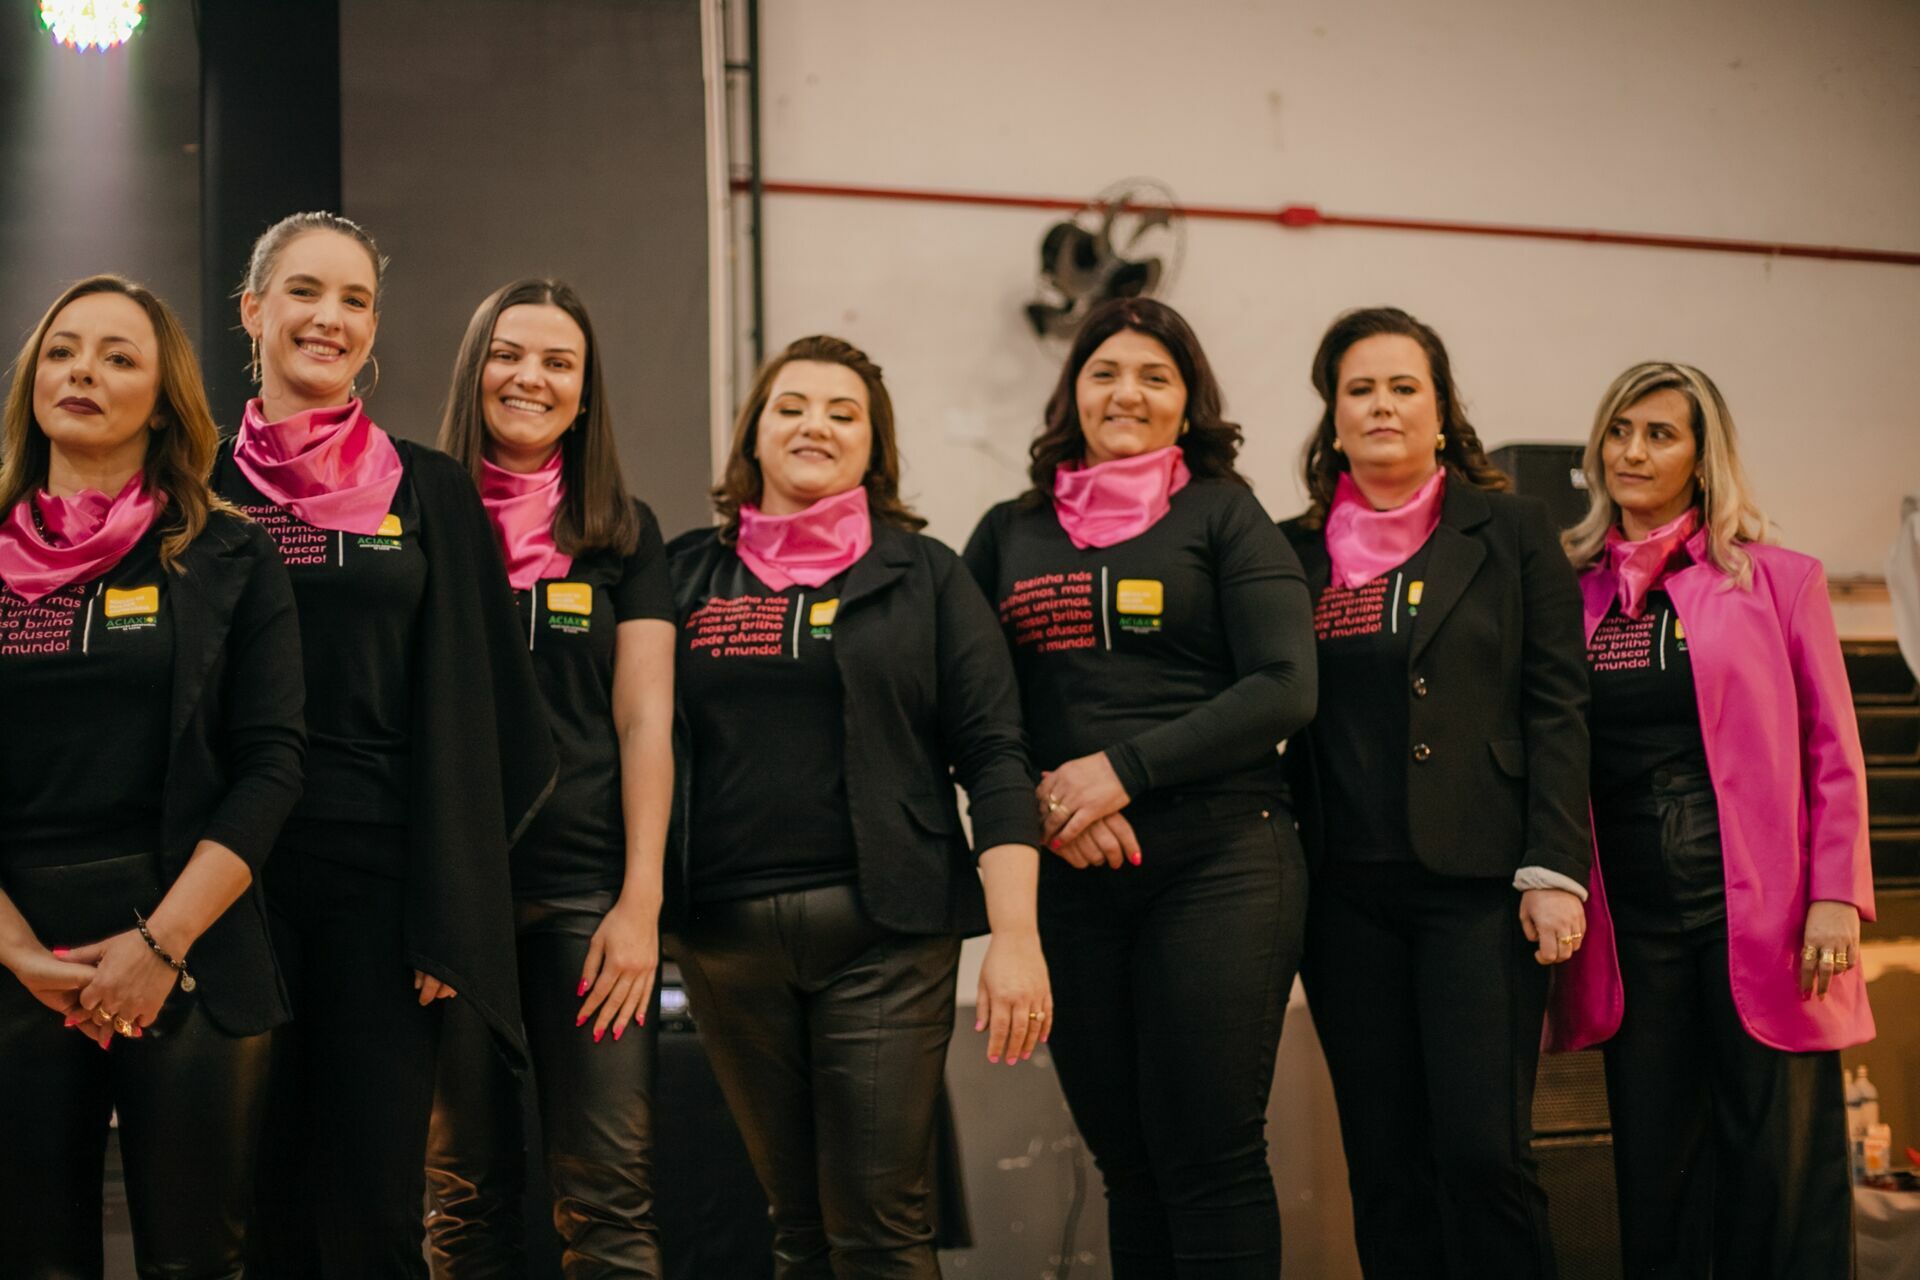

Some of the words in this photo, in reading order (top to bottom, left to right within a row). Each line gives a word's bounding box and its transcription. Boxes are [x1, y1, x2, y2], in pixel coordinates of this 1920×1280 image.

[240, 504, 282, 514] Sozin
[281, 533, 327, 544] brilho
[278, 544, 327, 555] fuscar
[284, 554, 327, 565] ndo!
[1013, 573, 1065, 592] Sozinha
[1060, 583, 1092, 595] mas
[46, 595, 82, 608] mas
[1051, 608, 1093, 622] brilho
[1345, 602, 1384, 616] brilho
[24, 618, 74, 629] brilho
[740, 618, 783, 631] brilho
[1046, 621, 1094, 637] ofuscar
[1330, 621, 1383, 639] mundo!
[1626, 623, 1654, 631] mas
[8, 629, 71, 641] ofuscar
[689, 634, 725, 649] pode
[728, 630, 783, 644] ofuscar
[1, 639, 70, 655] mundo!
[1046, 634, 1096, 651] mundo!
[1611, 639, 1651, 651] brilho
[711, 647, 721, 657] o
[724, 642, 783, 657] mundo!
[1598, 648, 1651, 661] ofuscar
[1594, 657, 1650, 671] mundo!
